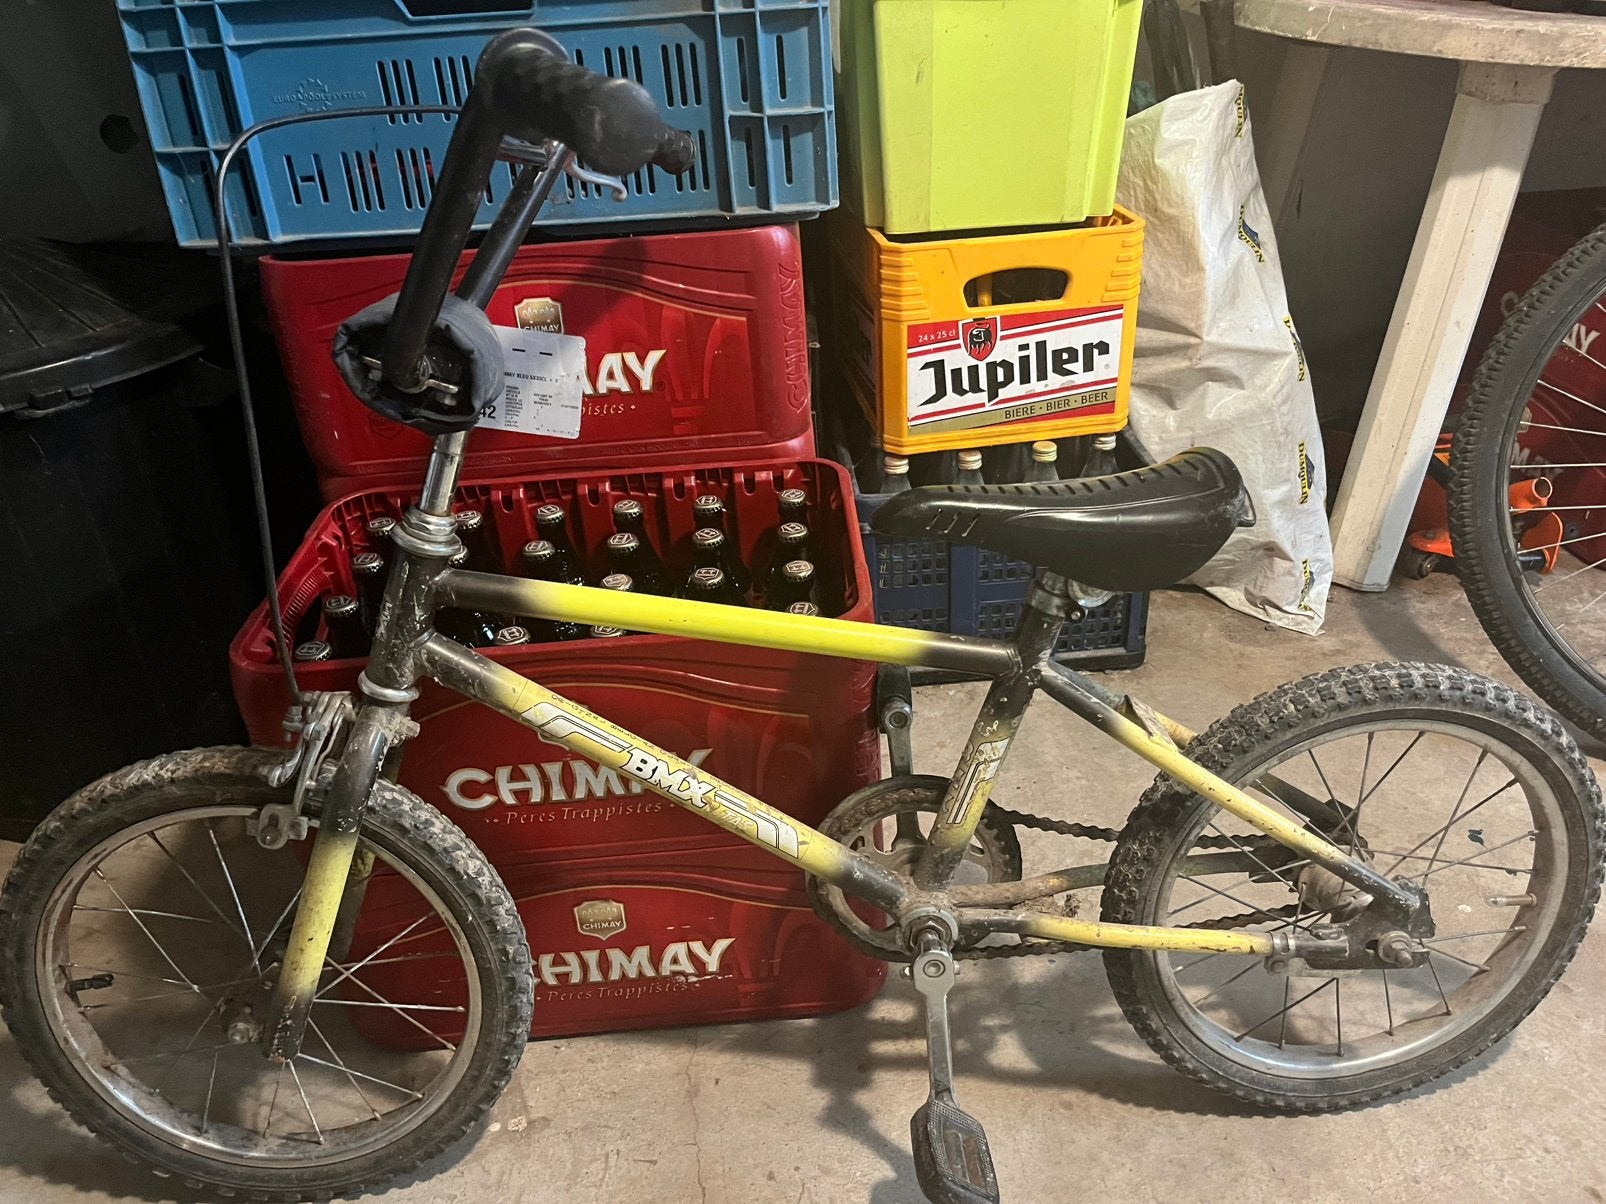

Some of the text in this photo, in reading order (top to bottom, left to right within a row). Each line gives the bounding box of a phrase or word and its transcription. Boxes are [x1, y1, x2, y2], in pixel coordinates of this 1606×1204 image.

[777, 262, 809, 414] CHIMAY
[918, 334, 929, 343] 24
[937, 331, 947, 339] 25
[949, 330, 956, 338] cl
[917, 340, 1110, 407] Jupiler
[1004, 392, 1108, 420] BIERE BIER BEER
[1298, 442, 1309, 505] DUMOULIN
[439, 748, 714, 809] CHIM
[619, 747, 717, 809] BMX
[562, 802, 662, 822] Trappistes
[582, 920, 622, 930] CHIMAY
[533, 938, 736, 986] HIMAY
[598, 981, 688, 999] Trappistes
